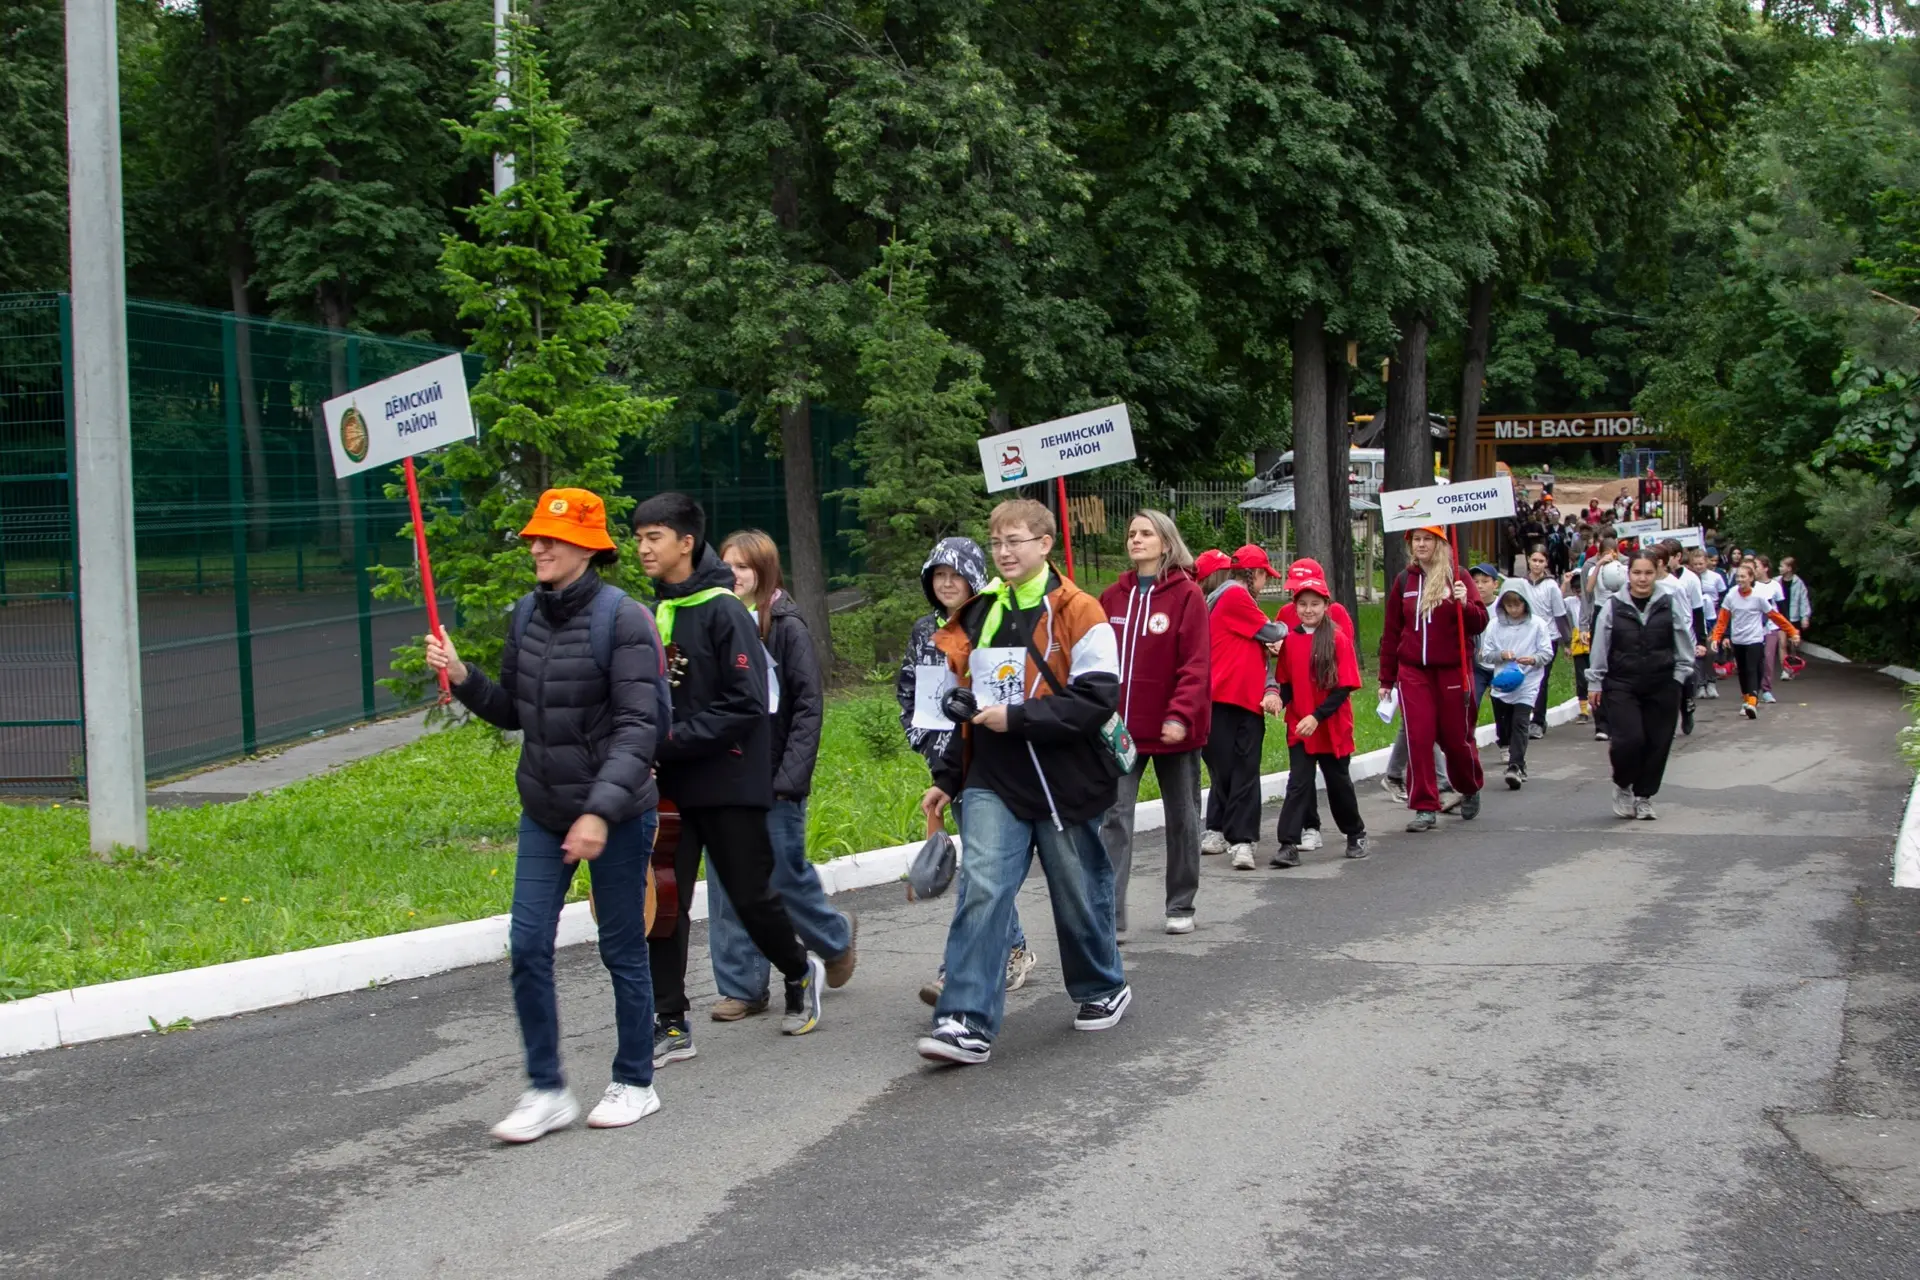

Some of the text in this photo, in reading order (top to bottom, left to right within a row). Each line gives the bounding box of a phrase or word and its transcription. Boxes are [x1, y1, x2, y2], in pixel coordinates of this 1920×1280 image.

[385, 381, 443, 420] ДЁМСКИЙ
[397, 411, 438, 437] РАЙОН
[1040, 419, 1114, 449] ЛЕНИНСКИЙ
[1495, 420, 1533, 439] МЫ
[1541, 419, 1586, 437] ВАС
[1059, 441, 1101, 460] РАЙОН
[1437, 488, 1498, 505] СОВЕТСКИЙ
[1451, 503, 1487, 514] РАЙОН
